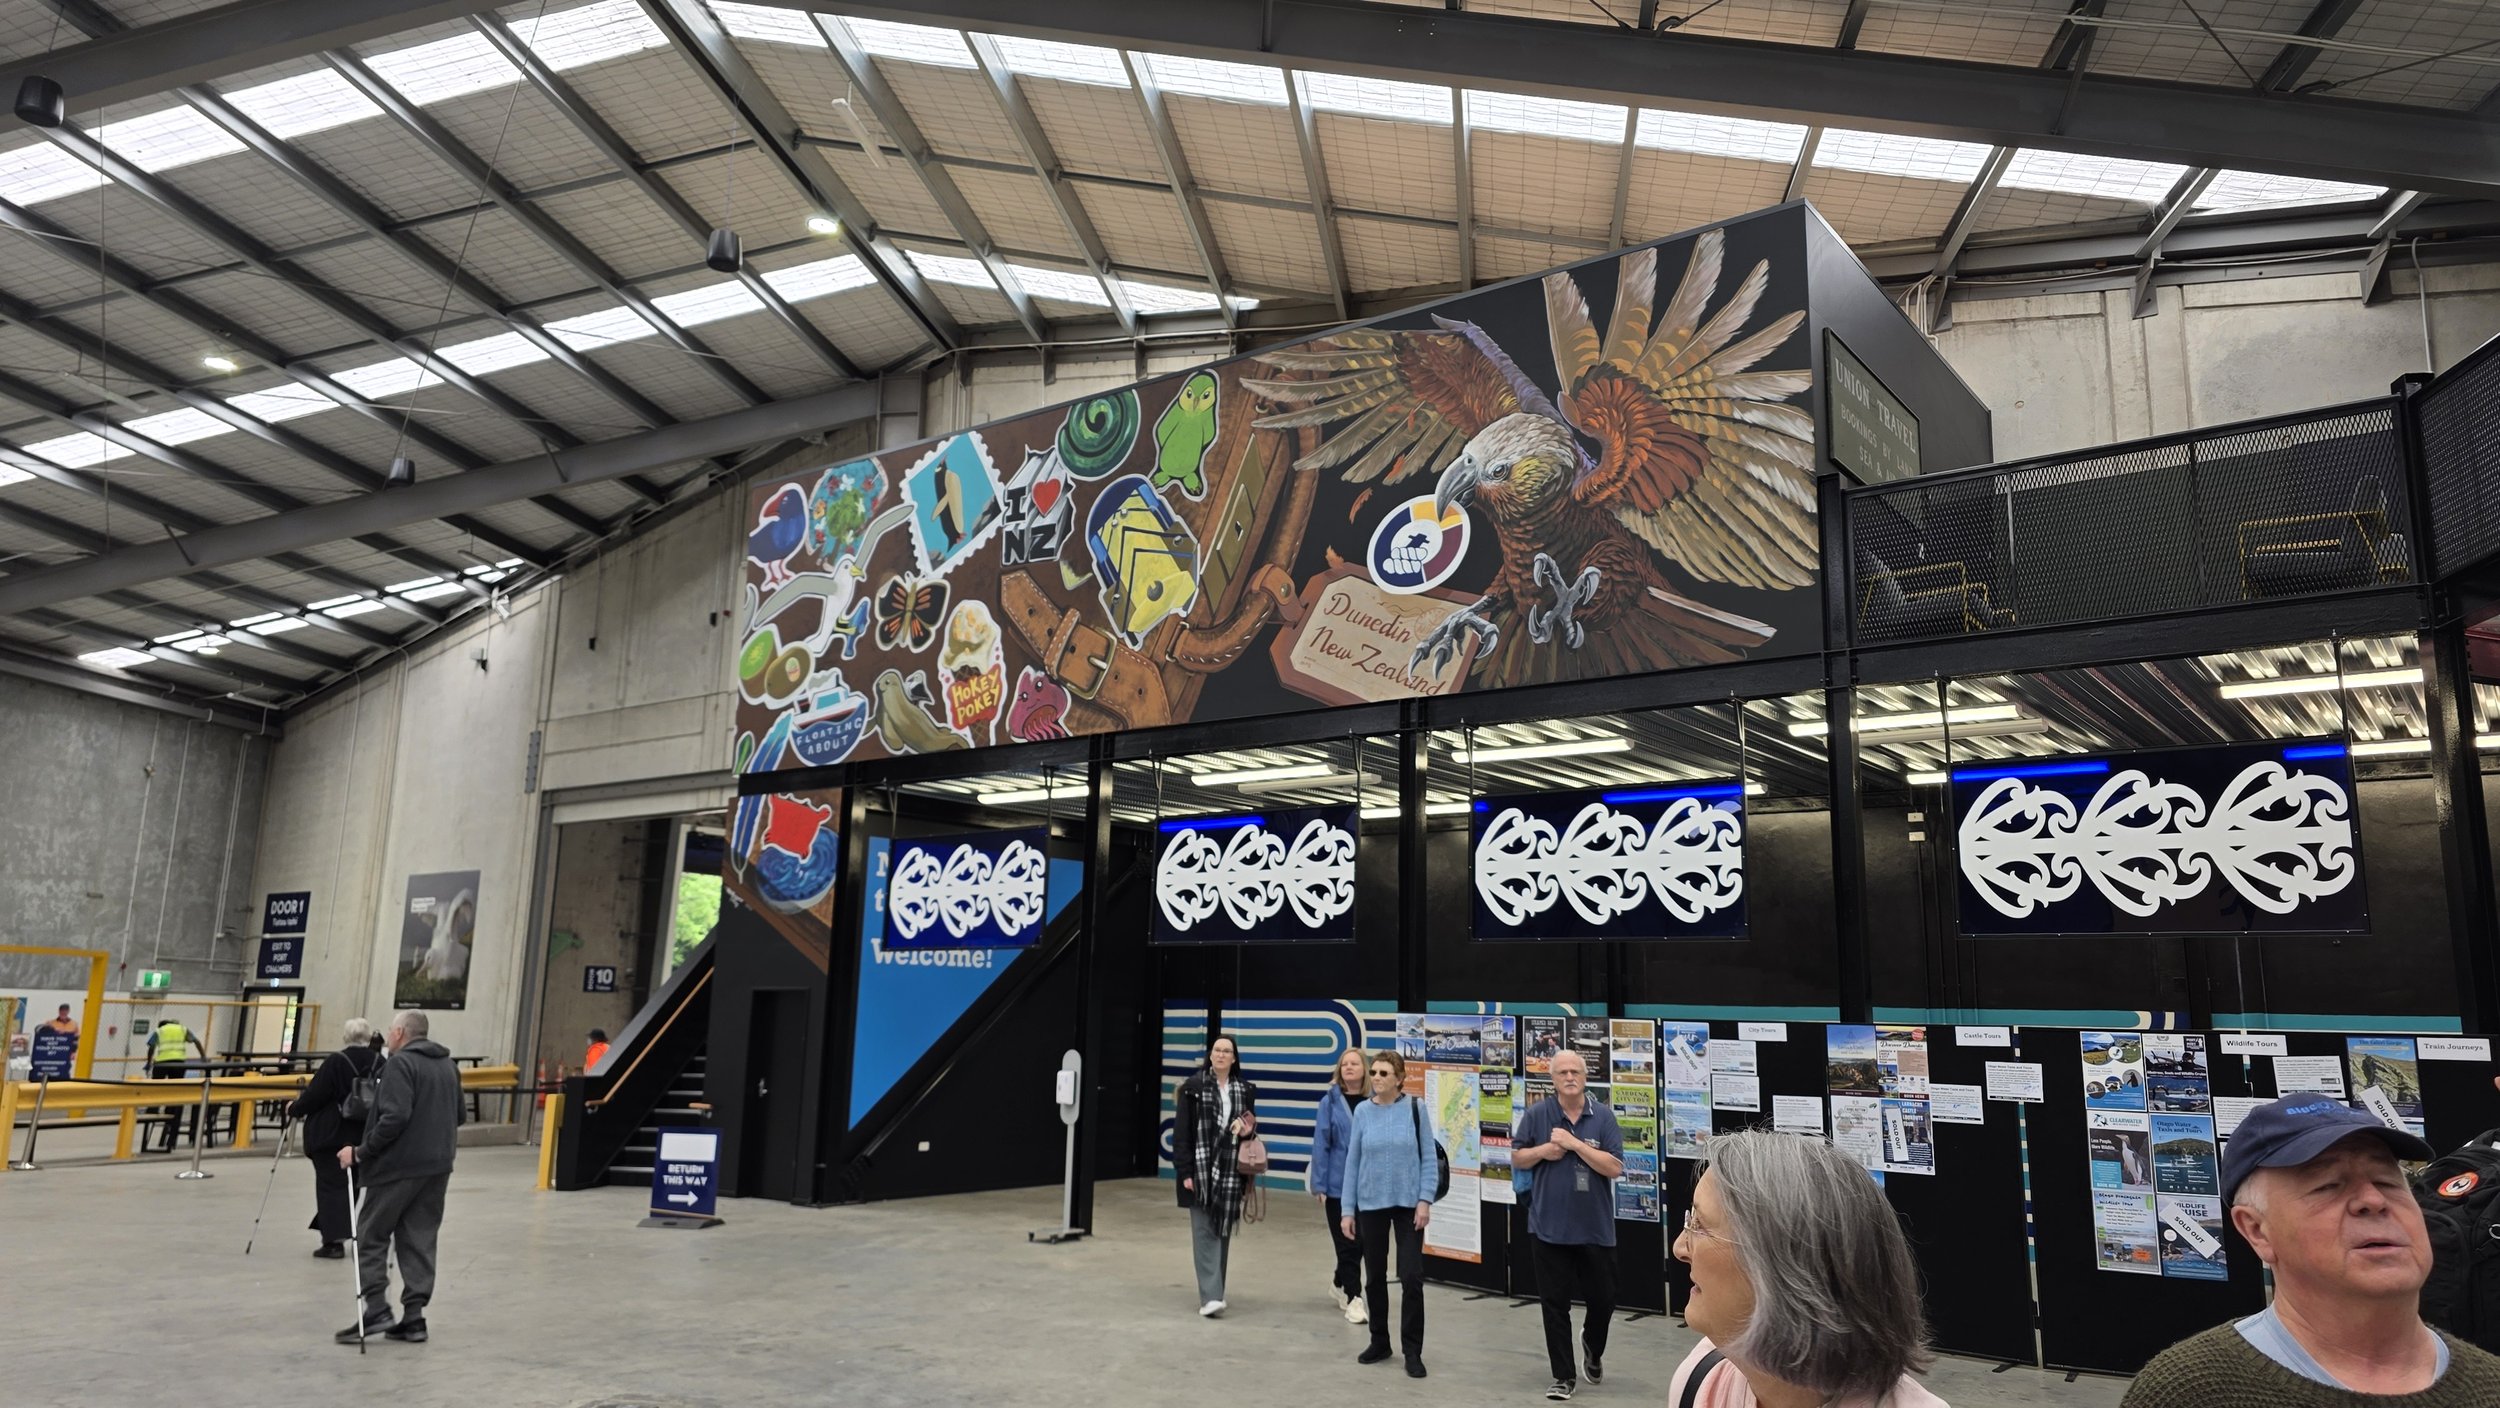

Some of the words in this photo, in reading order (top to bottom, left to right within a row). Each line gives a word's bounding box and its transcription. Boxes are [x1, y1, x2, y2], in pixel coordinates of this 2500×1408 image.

[1835, 358, 1870, 410] UNION
[1877, 399, 1916, 454] TRAVEL
[1841, 403, 1878, 448] BOOKINGS
[1882, 442, 1891, 461] BY
[1860, 445, 1873, 470] SEA
[1876, 462, 1882, 478] &
[1003, 523, 1058, 564] NZ
[1324, 592, 1412, 643] Dunedin
[1309, 626, 1352, 660] New
[1351, 643, 1446, 695] Zealand
[957, 684, 1000, 725] POKEY
[796, 717, 863, 746] FLOATING
[807, 735, 848, 755] ABOUT
[270, 900, 298, 915] DOOR
[300, 900, 304, 914] 1
[871, 938, 992, 968] Welcome!
[596, 968, 613, 984] 10
[1680, 1046, 1691, 1061] SOLD
[1689, 1060, 1698, 1070] OUT
[2374, 1100, 2388, 1118] SOLD
[663, 1175, 684, 1186] THIS
[684, 1176, 708, 1186] WAY
[668, 1164, 704, 1174] RETURN
[2174, 1216, 2191, 1232] SOLD
[2191, 1231, 2205, 1244] OUT
